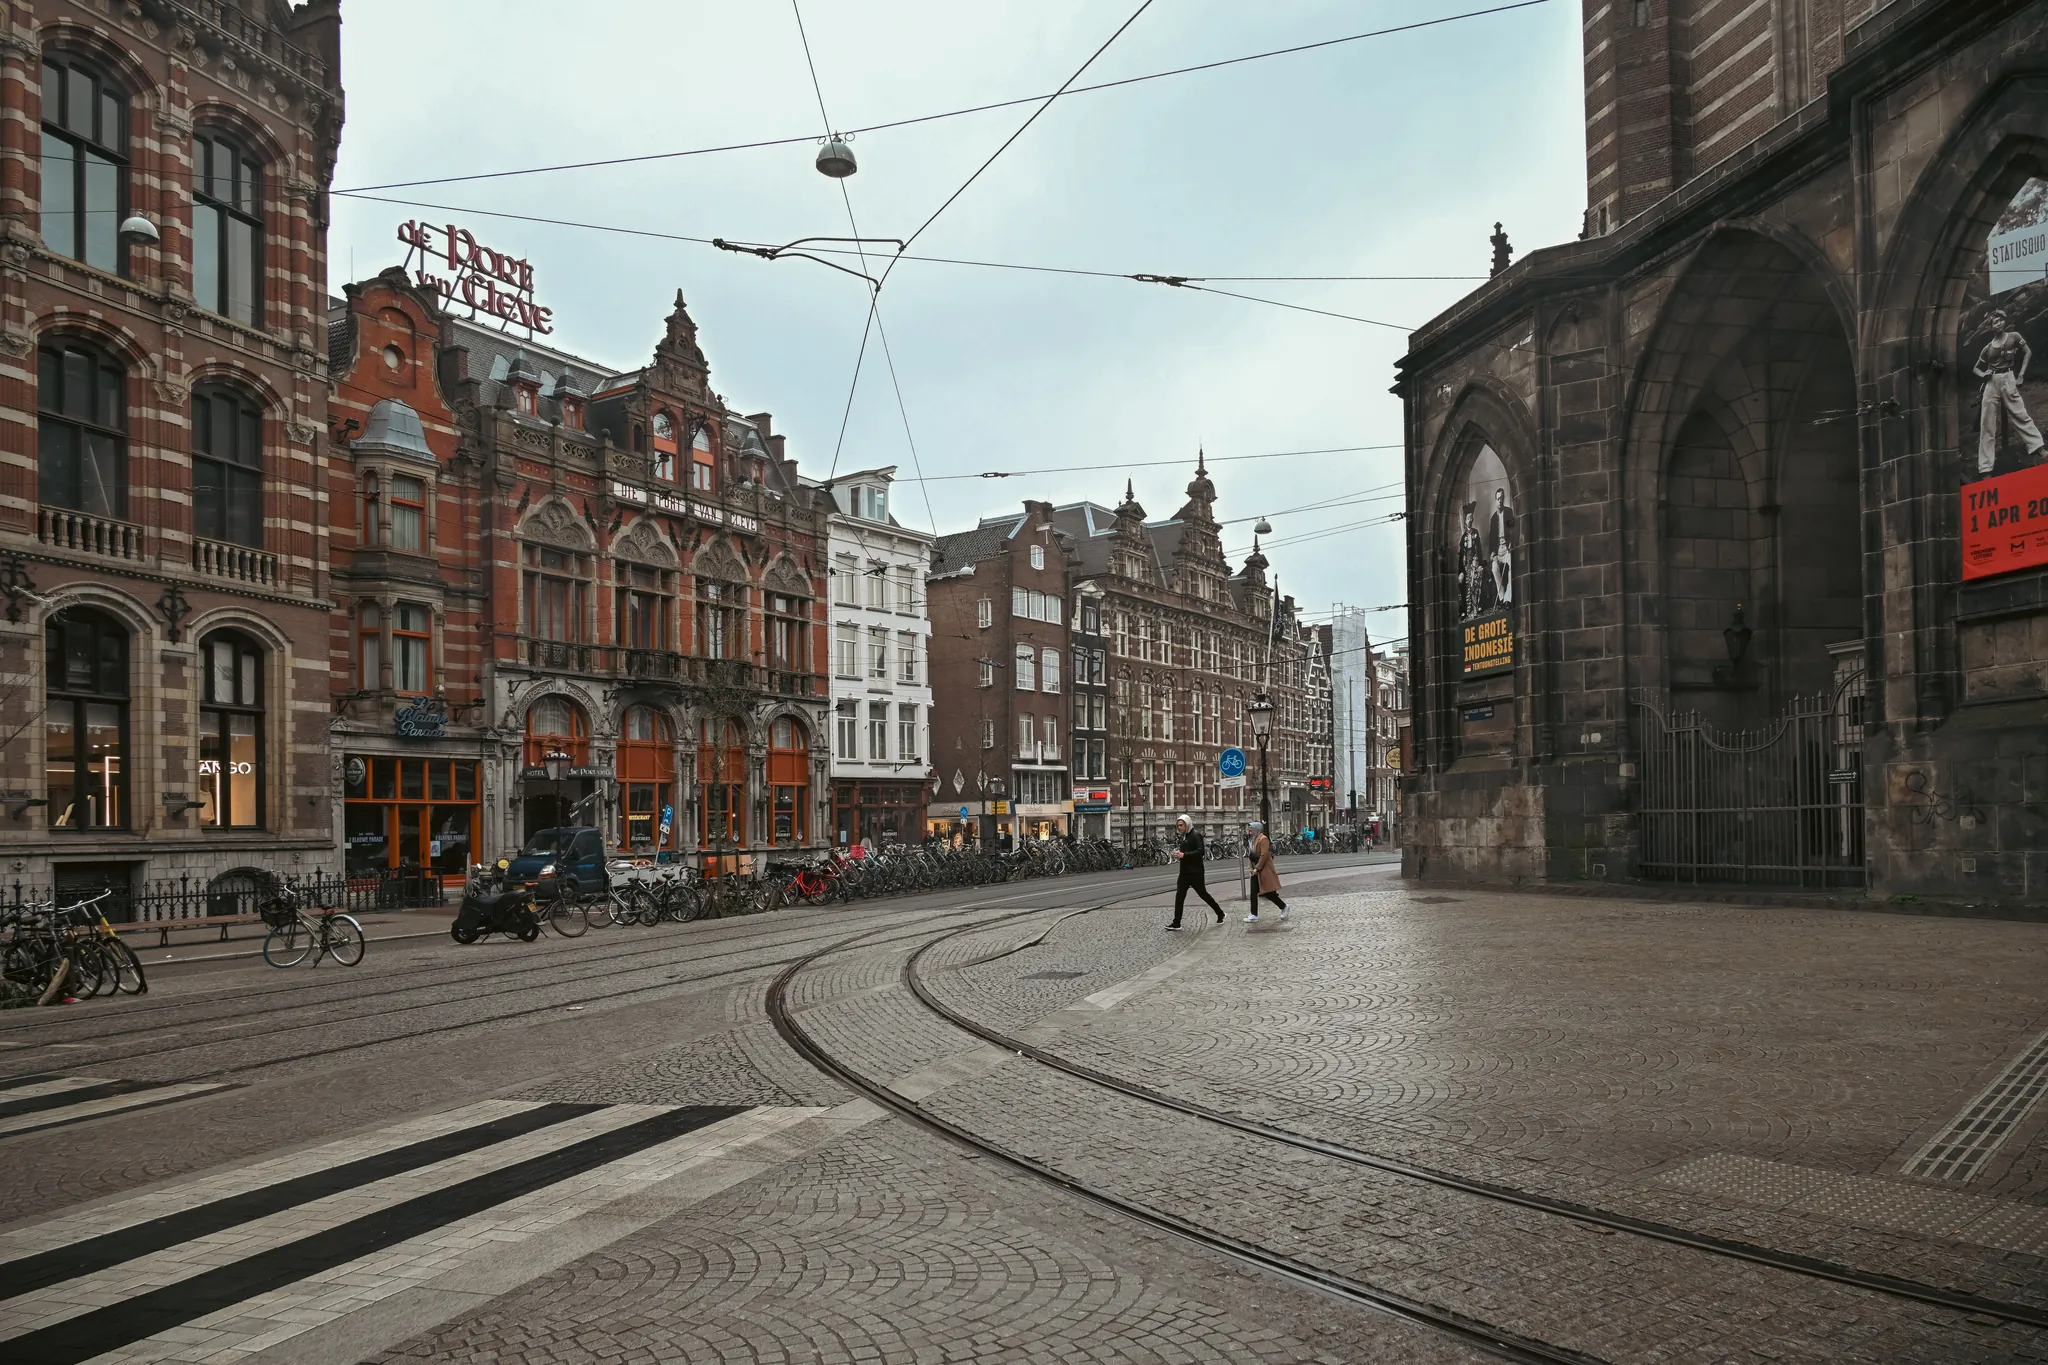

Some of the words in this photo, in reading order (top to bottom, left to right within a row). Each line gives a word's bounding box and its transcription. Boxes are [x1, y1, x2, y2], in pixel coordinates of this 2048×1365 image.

[1992, 233, 2046, 265] STATUSQUO
[621, 484, 638, 500] DIE
[659, 494, 682, 513] PORT
[699, 504, 718, 521] VAN
[730, 513, 756, 532] CLEVE
[1969, 487, 1999, 511] T/M
[1970, 515, 1979, 533] 1
[1987, 505, 2020, 529] APR
[1464, 626, 1476, 644] DE
[1478, 617, 1507, 640] GROTE
[1464, 632, 1513, 662] INDONESIË
